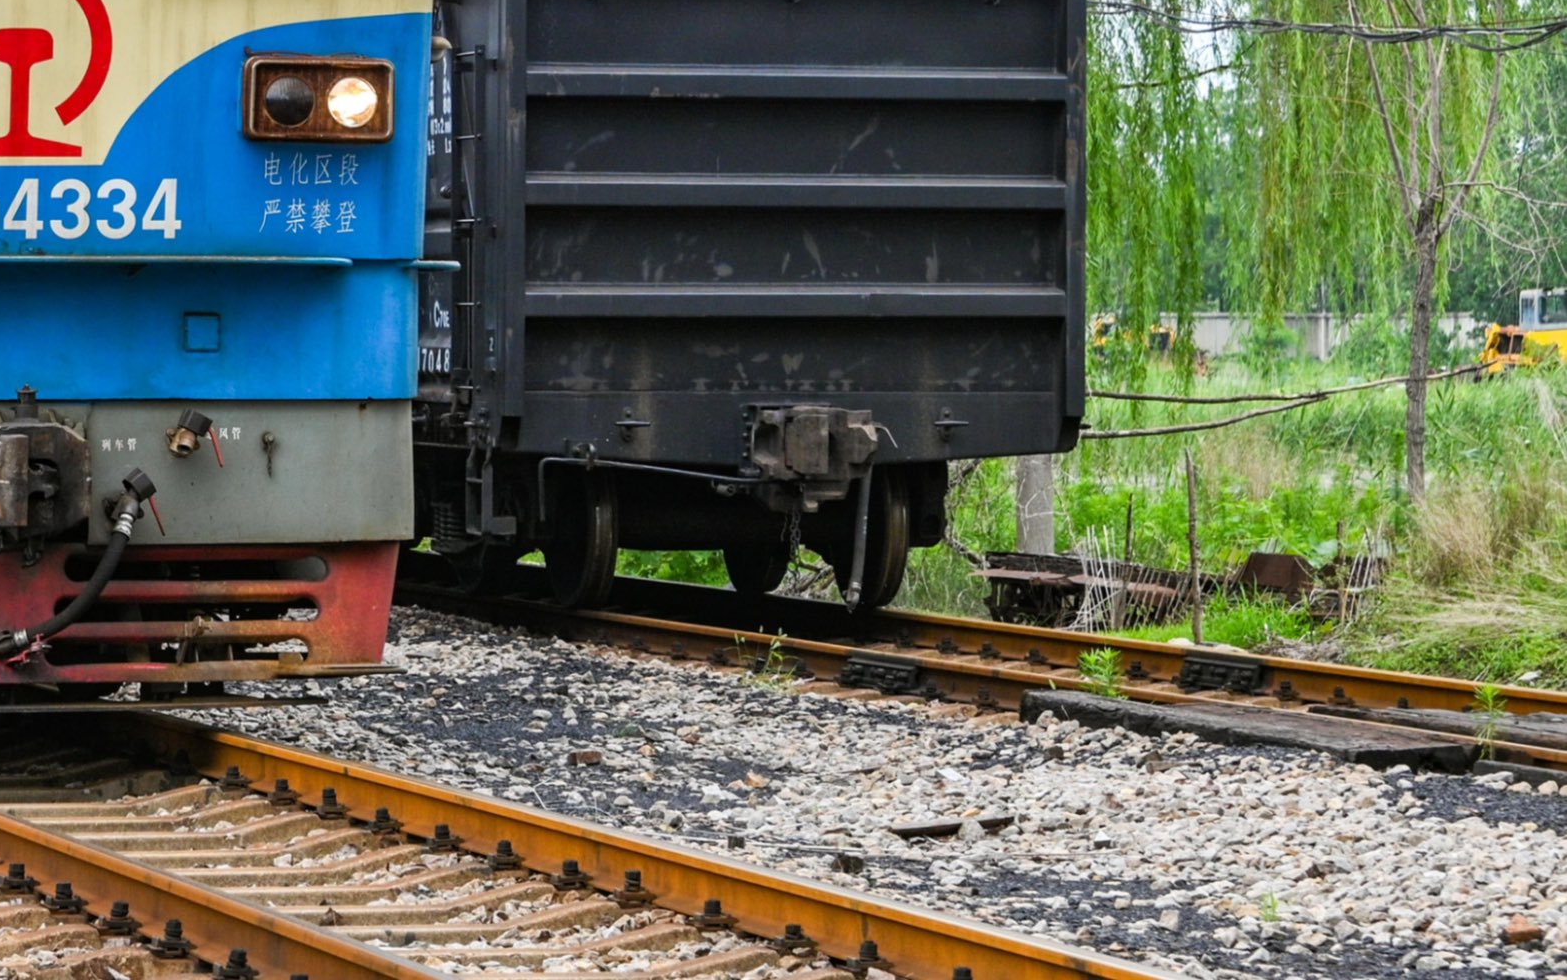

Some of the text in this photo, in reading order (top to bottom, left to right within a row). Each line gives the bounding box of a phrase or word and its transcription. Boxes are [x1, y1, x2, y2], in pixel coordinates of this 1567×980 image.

[263, 151, 360, 186] 电化区段
[259, 198, 357, 234] 严禁攀登
